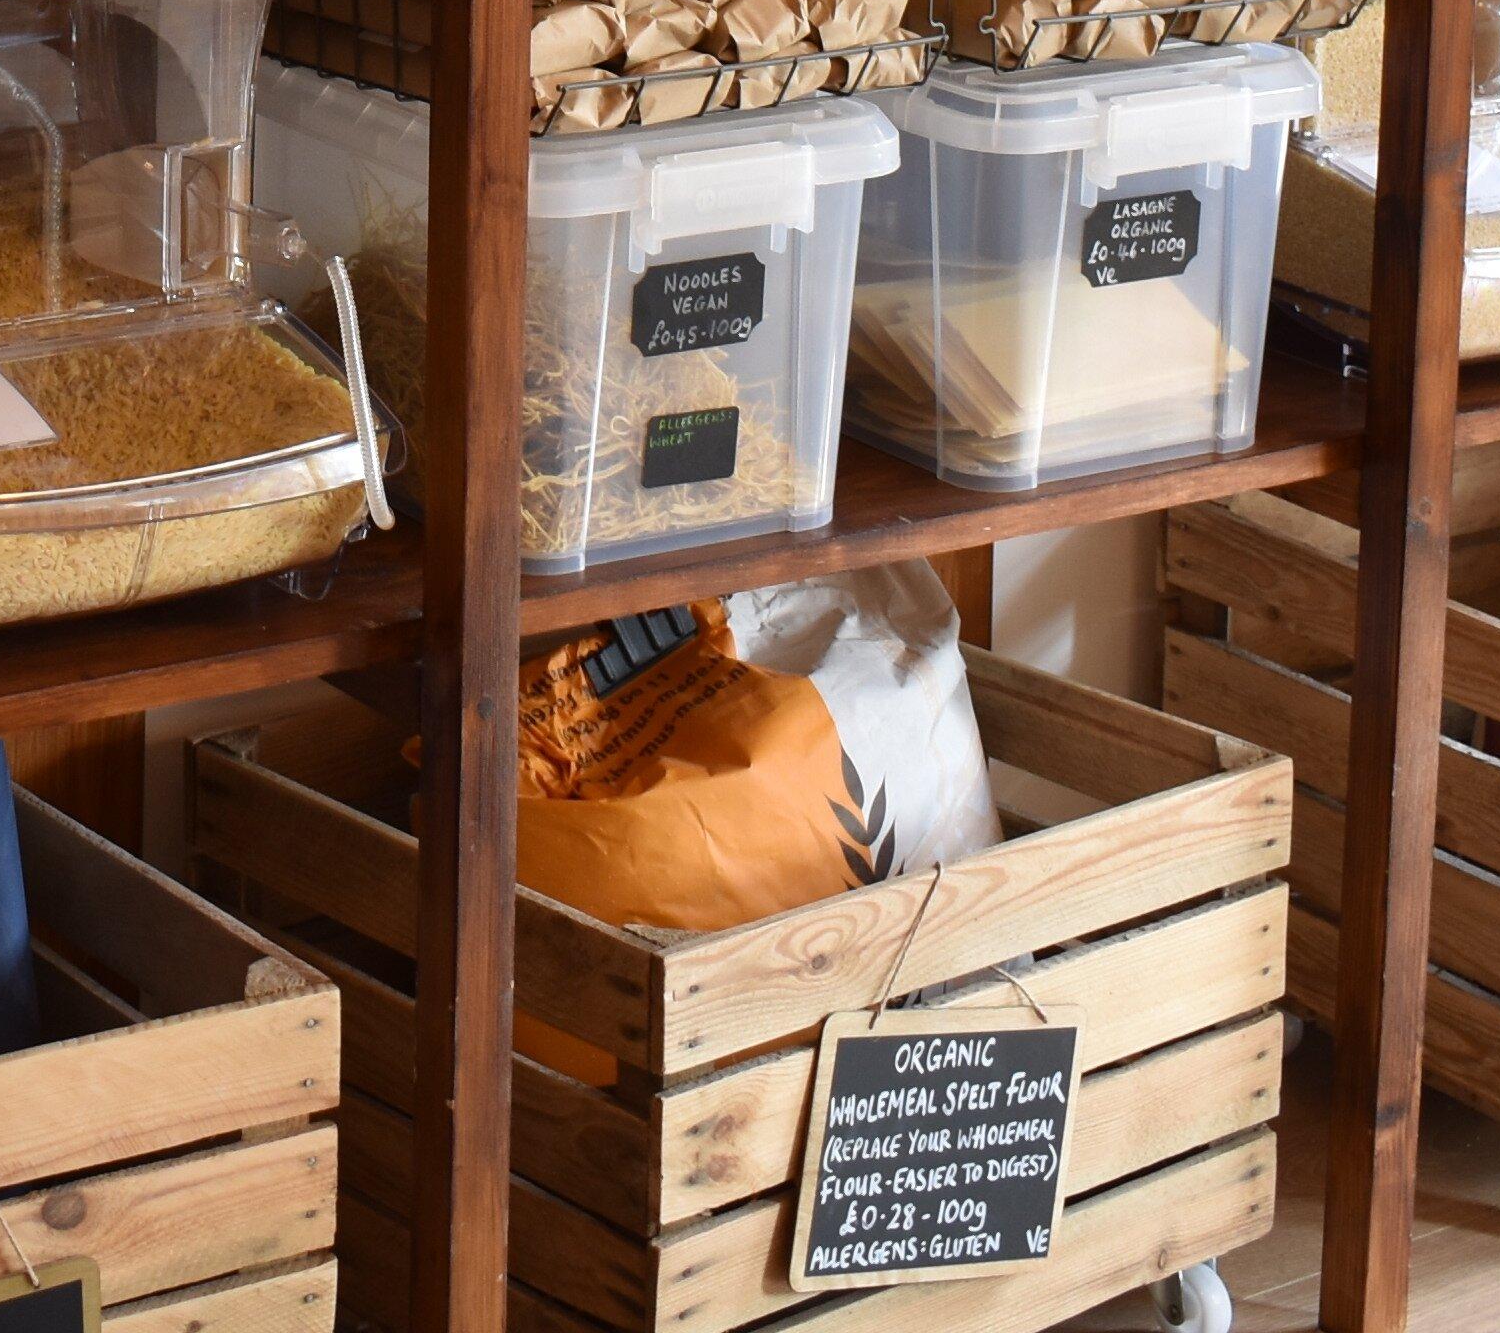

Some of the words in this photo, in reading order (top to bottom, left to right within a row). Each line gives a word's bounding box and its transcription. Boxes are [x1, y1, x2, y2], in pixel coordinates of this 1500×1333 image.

[1112, 195, 1177, 220] LASAGNE
[1110, 219, 1173, 239] ORGANIC
[662, 264, 743, 295] NOODLES
[671, 290, 729, 316] VEGAN
[648, 430, 694, 449] WHEAT
[894, 1036, 997, 1075] ORGANIC
[828, 1087, 938, 1129] WHOLEMEAL
[941, 1080, 1002, 1117] SPELT
[1005, 1070, 1066, 1108] FLOUR
[822, 1132, 902, 1174] (REPLACE
[908, 1127, 953, 1156] YOUR
[956, 1117, 1056, 1151] WHOLEMEAL
[961, 1161, 983, 1185] TO
[986, 1142, 1058, 1181] DIGEST)
[936, 1197, 988, 1233] 100g
[928, 1232, 1001, 1260] GLUTEN
[1025, 1224, 1050, 1254] VE
